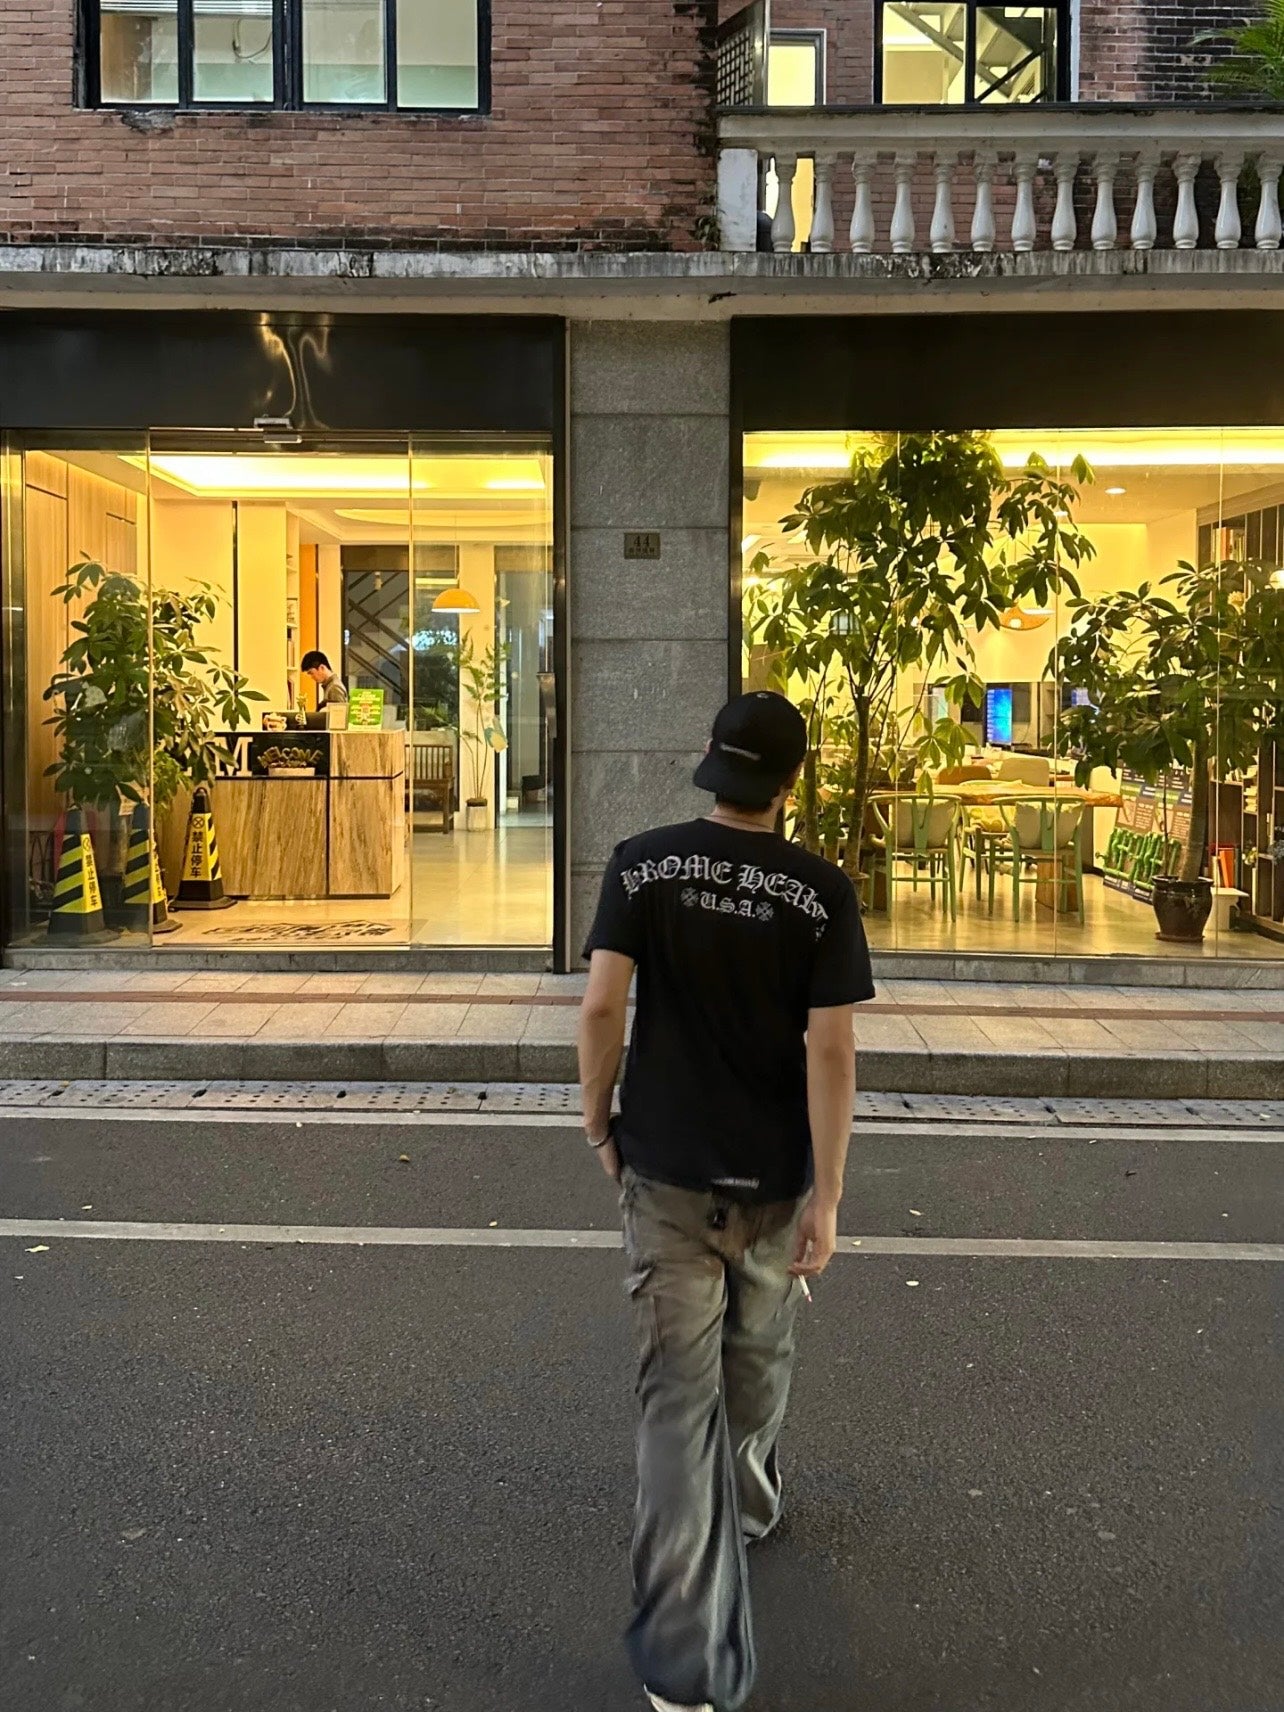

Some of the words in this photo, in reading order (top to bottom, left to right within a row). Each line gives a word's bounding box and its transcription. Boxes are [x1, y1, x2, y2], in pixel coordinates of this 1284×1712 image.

[191, 832, 203, 877] 禁止停车
[86, 854, 98, 906] 禁止停车
